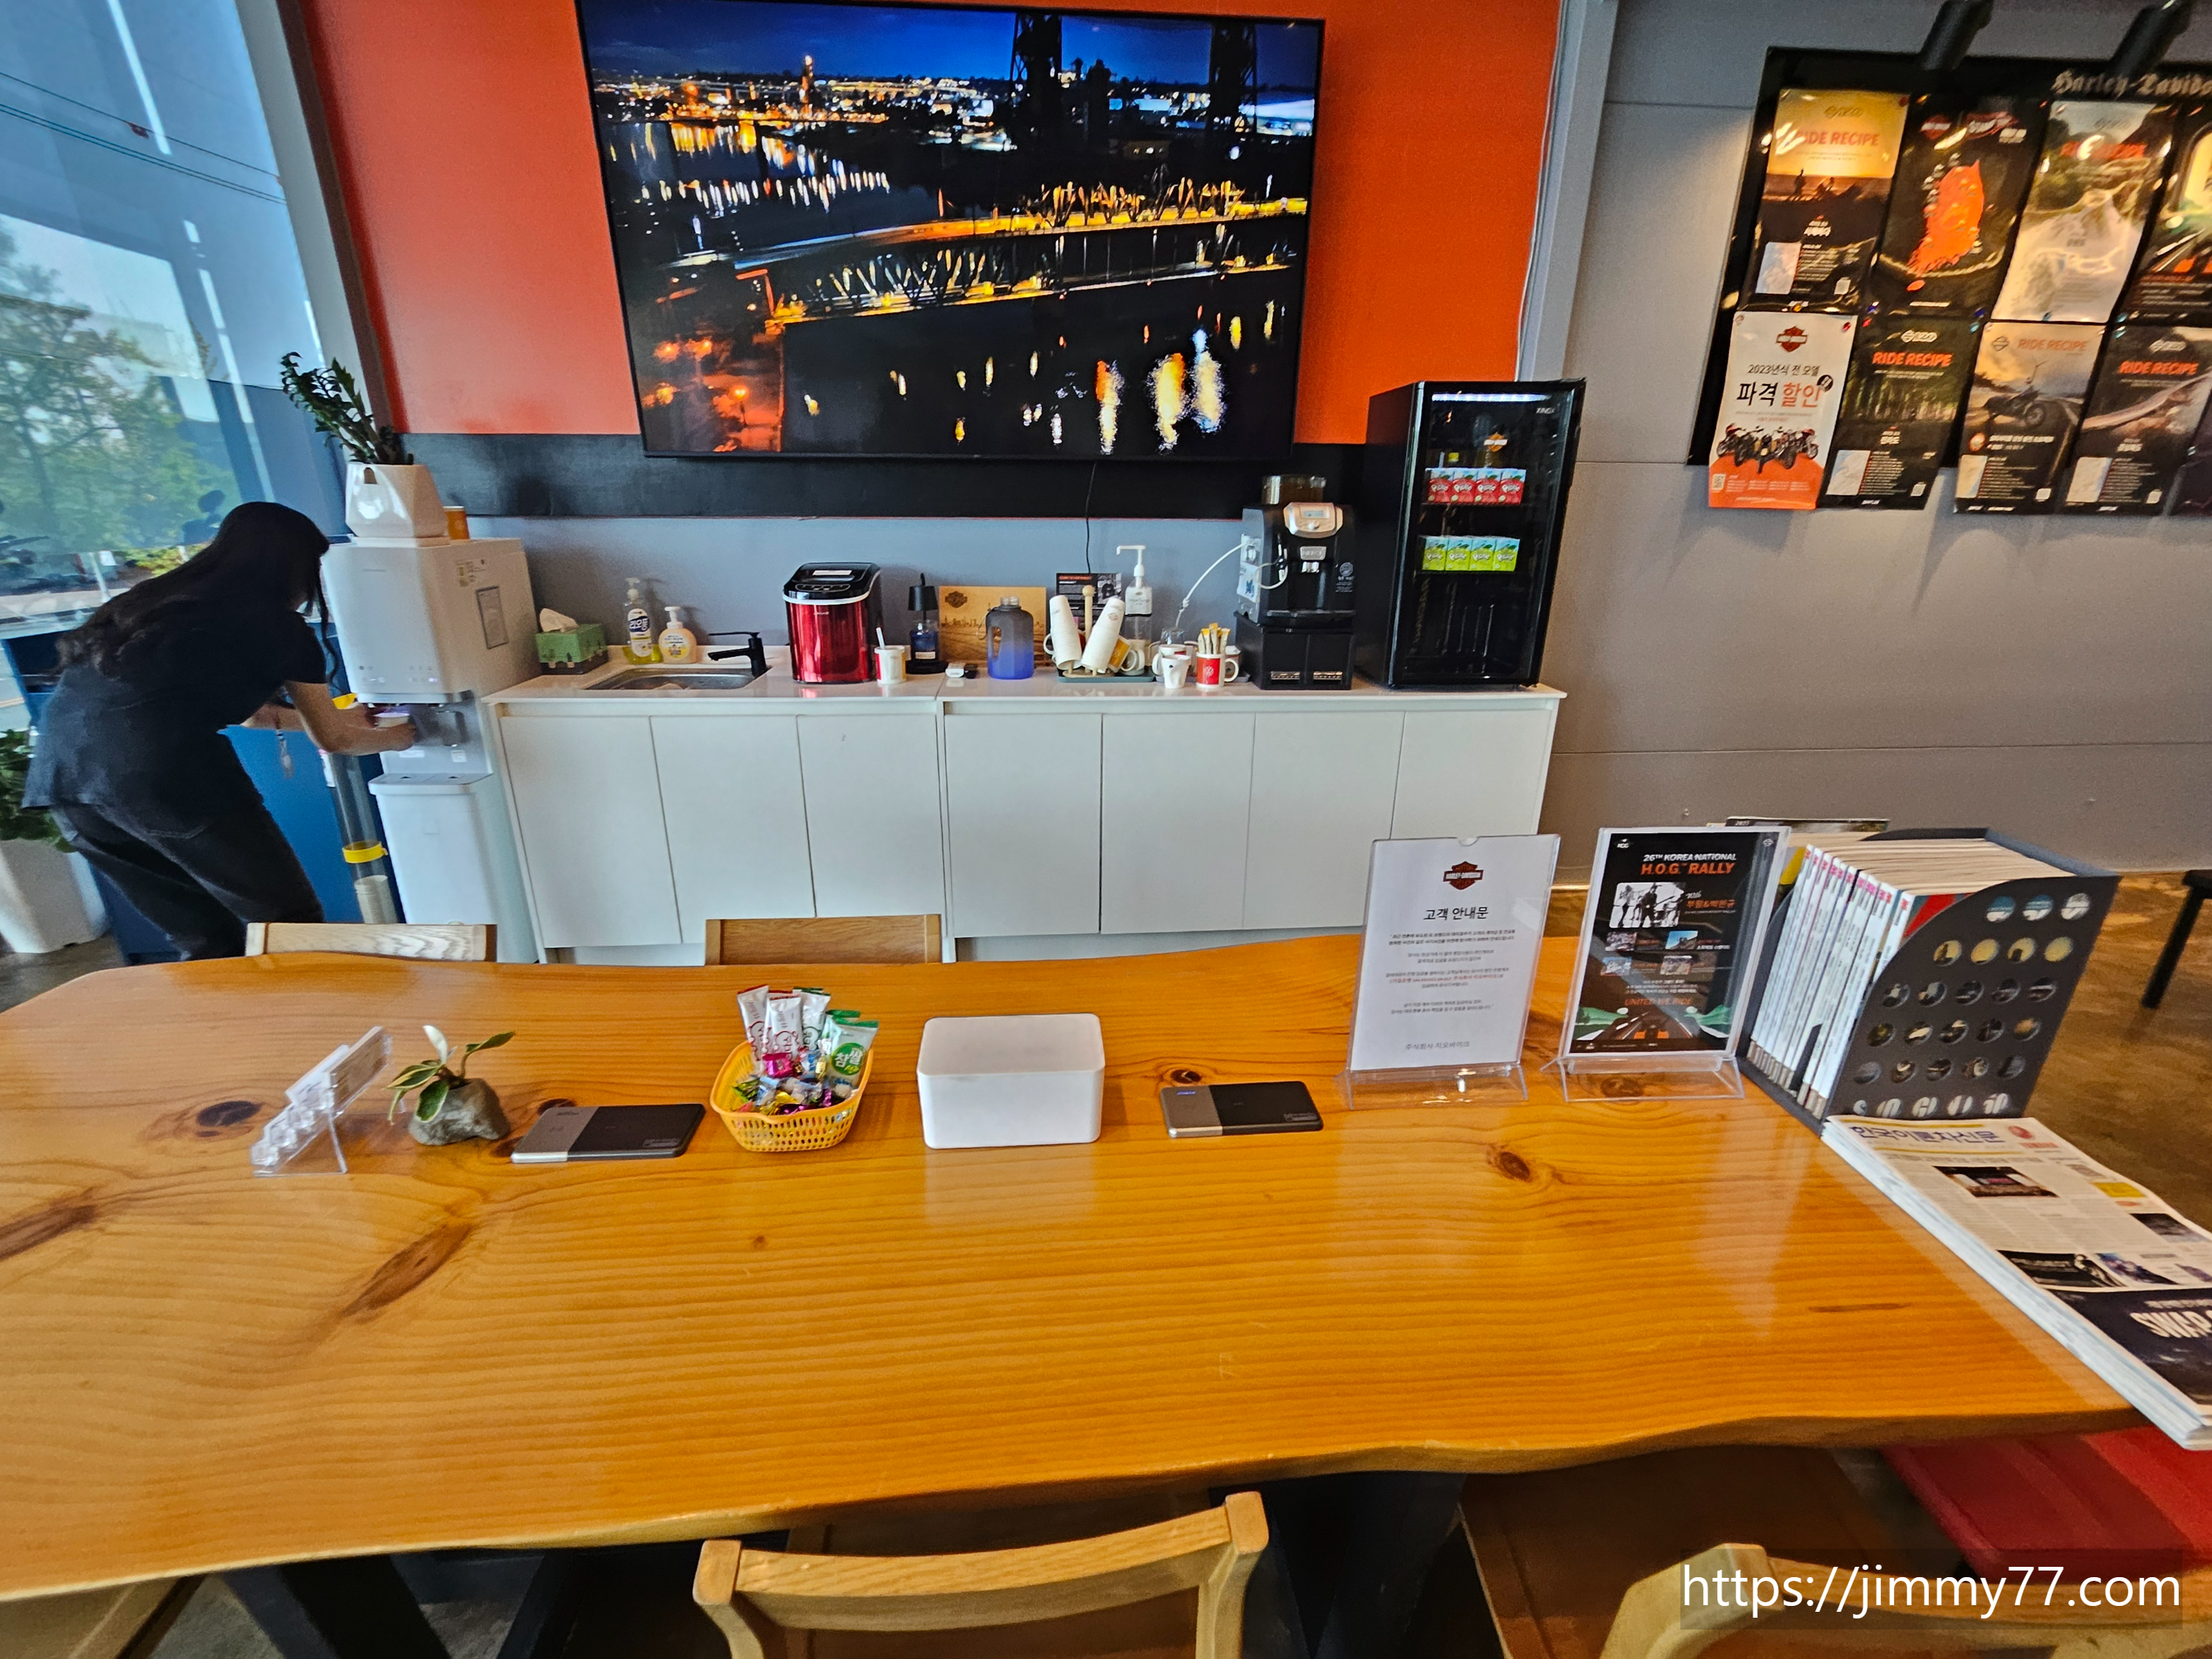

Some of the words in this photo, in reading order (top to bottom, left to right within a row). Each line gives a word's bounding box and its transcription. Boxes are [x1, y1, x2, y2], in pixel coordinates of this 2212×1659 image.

[1830, 131, 1879, 146] RECIPE
[2018, 339, 2046, 349] RIDE
[2047, 340, 2088, 351] RECIPE
[1872, 352, 1905, 365] RIDE
[1905, 352, 1953, 367] RECIPE
[1747, 364, 1790, 375] 2023년식
[1792, 364, 1801, 375] 전
[2118, 361, 2152, 374] RIDE
[2151, 362, 2199, 375] RECIPE
[1736, 381, 1778, 406] 파격
[1781, 382, 1822, 407] 할인
[1688, 862, 1735, 874] RALLY
[1423, 908, 1449, 921] 고객
[1453, 906, 1489, 920] 안내문
[1405, 1042, 1433, 1050] 주식회사
[1435, 1040, 1470, 1048] 지오바이크
[1849, 1126, 2005, 1143] 한국이륜차신문
